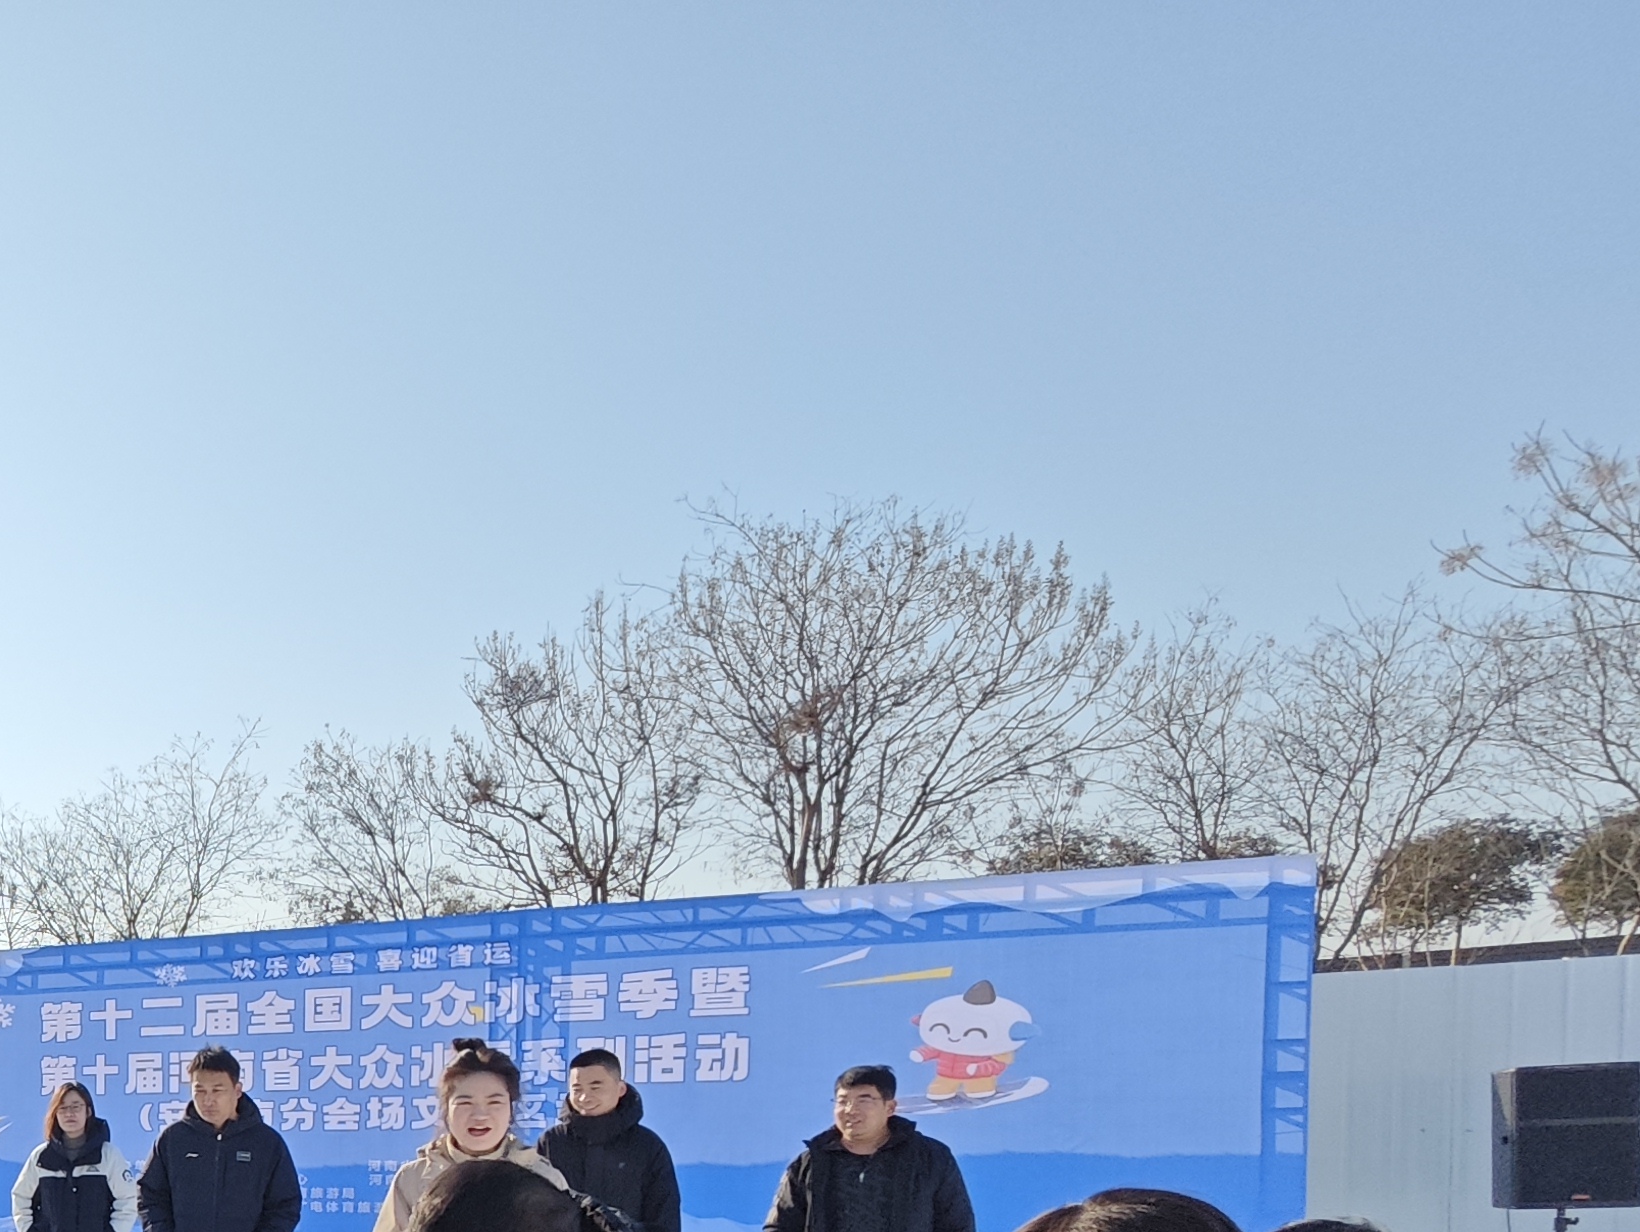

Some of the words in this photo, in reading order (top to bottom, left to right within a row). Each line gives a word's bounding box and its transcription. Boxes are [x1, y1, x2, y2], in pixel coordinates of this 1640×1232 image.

[231, 950, 357, 982] 欢乐冰雪
[375, 940, 513, 972] 喜迎省运
[39, 965, 752, 1043] 第十二届全国大众冰雪季暨
[39, 1031, 752, 1097] 第十届河省大众冰系列活动
[367, 1158, 409, 1172] 河南
[301, 1200, 383, 1214] 电体育旅
